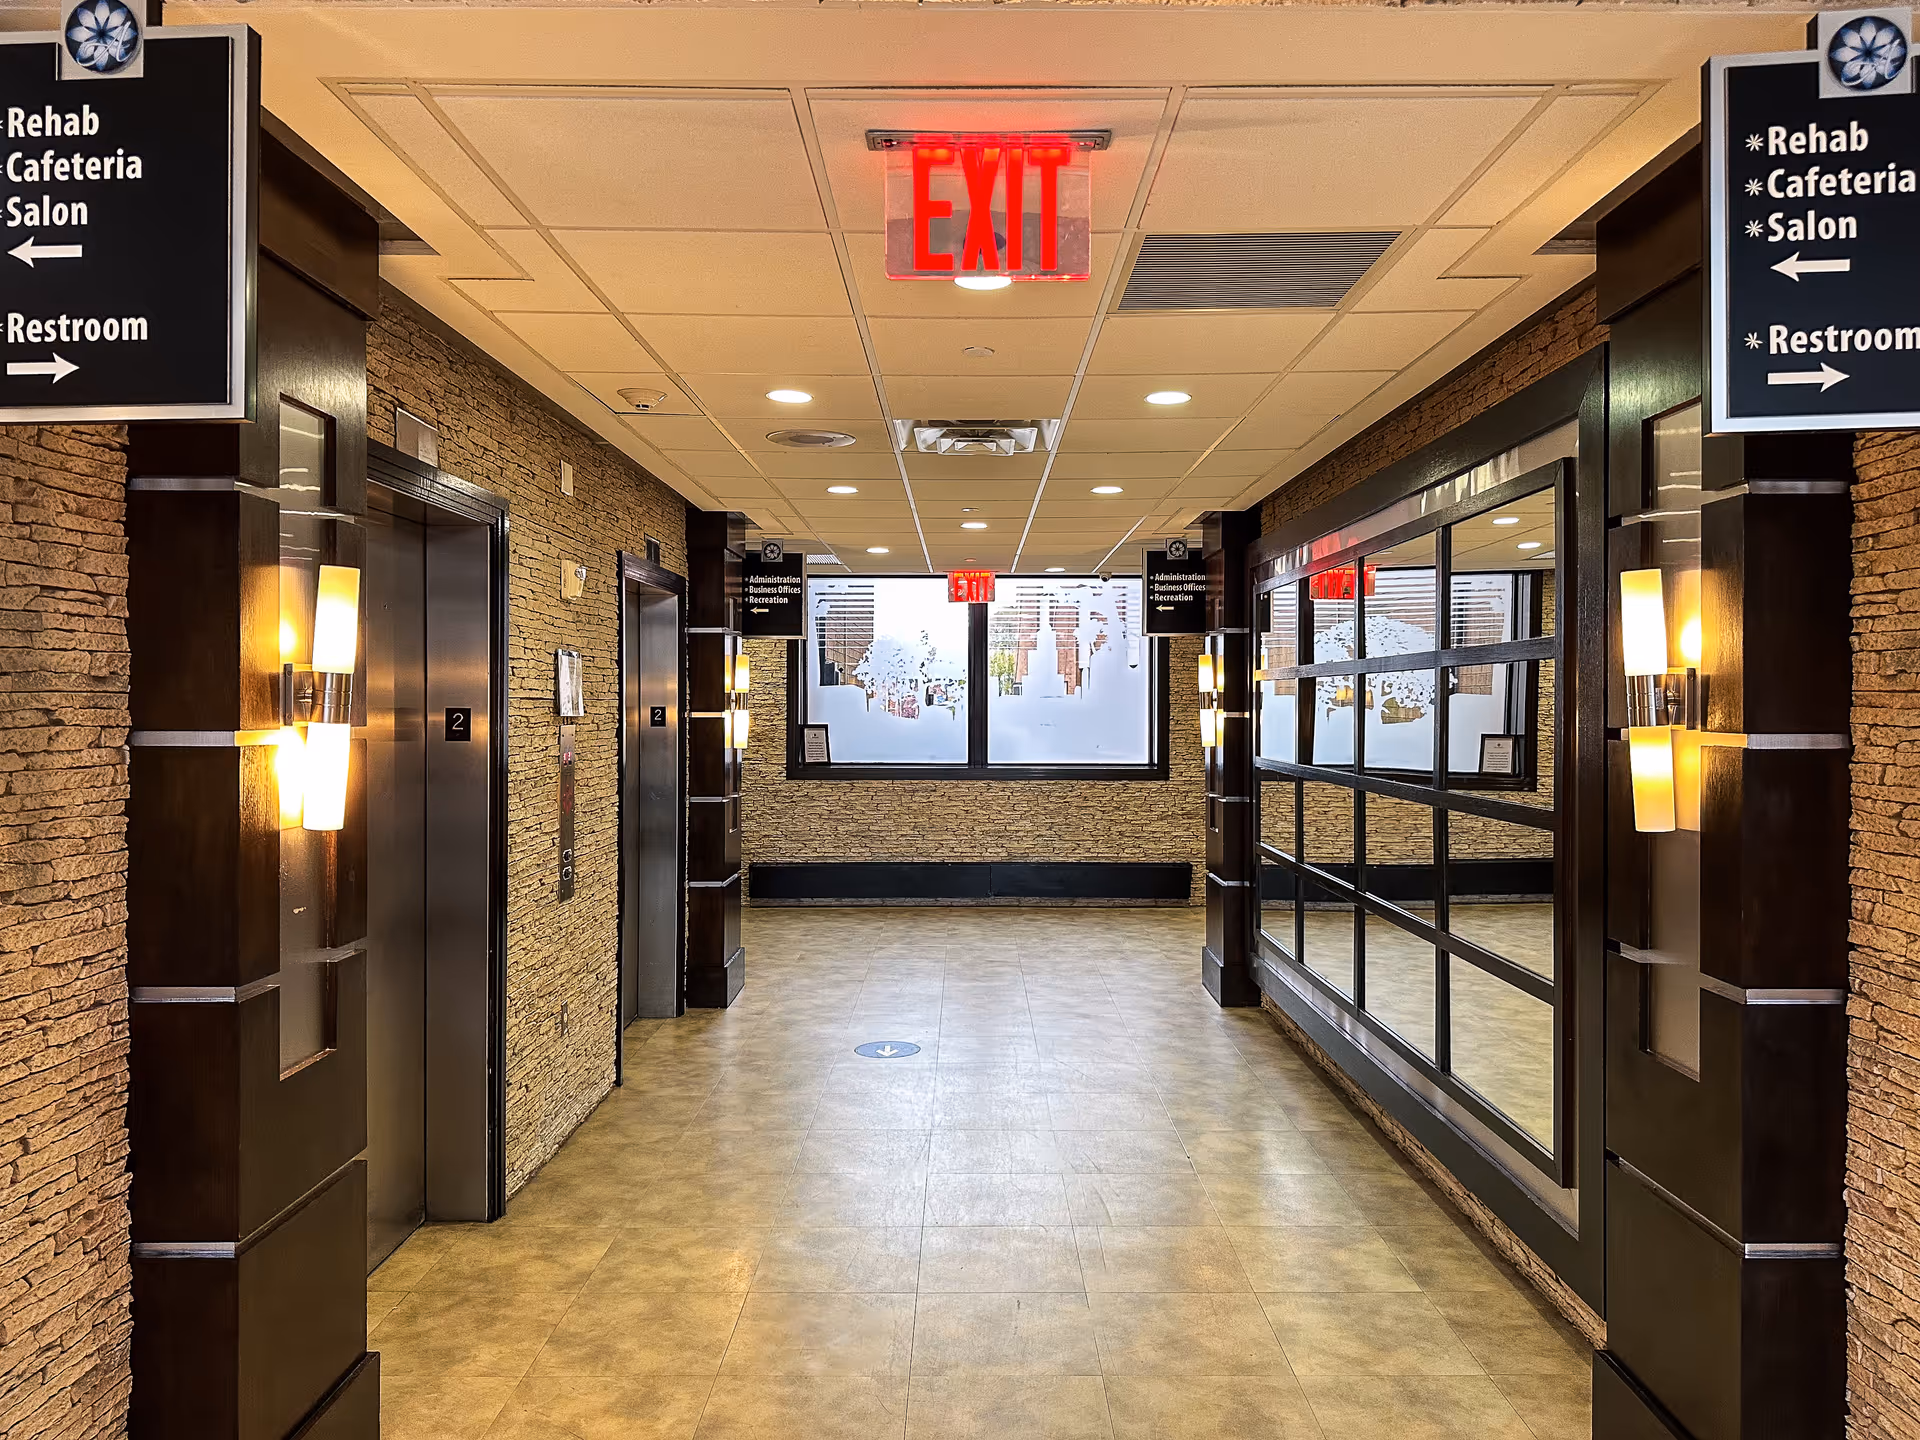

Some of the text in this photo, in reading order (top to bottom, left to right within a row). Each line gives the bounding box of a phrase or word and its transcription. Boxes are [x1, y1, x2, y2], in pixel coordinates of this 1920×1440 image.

[7, 104, 100, 138] Rehab
[1768, 121, 1869, 155] Rehab
[6, 148, 143, 182] Cafeteria
[1767, 163, 1916, 199] Cafeteria
[7, 195, 88, 228] Salon
[912, 147, 1070, 271] EXIT
[1767, 210, 1857, 243] Salon
[7, 313, 148, 343] Restroom
[1769, 324, 1920, 355] Restroom
[749, 575, 801, 584] Administration
[749, 585, 801, 594] Business Offices
[953, 572, 991, 602] EXIT
[1154, 573, 1206, 581] Administration
[1154, 583, 1206, 592] Business Offices
[749, 596, 789, 604] Recreation
[1154, 593, 1193, 602] Recreation
[452, 713, 464, 730] 2
[654, 709, 662, 721] 2
